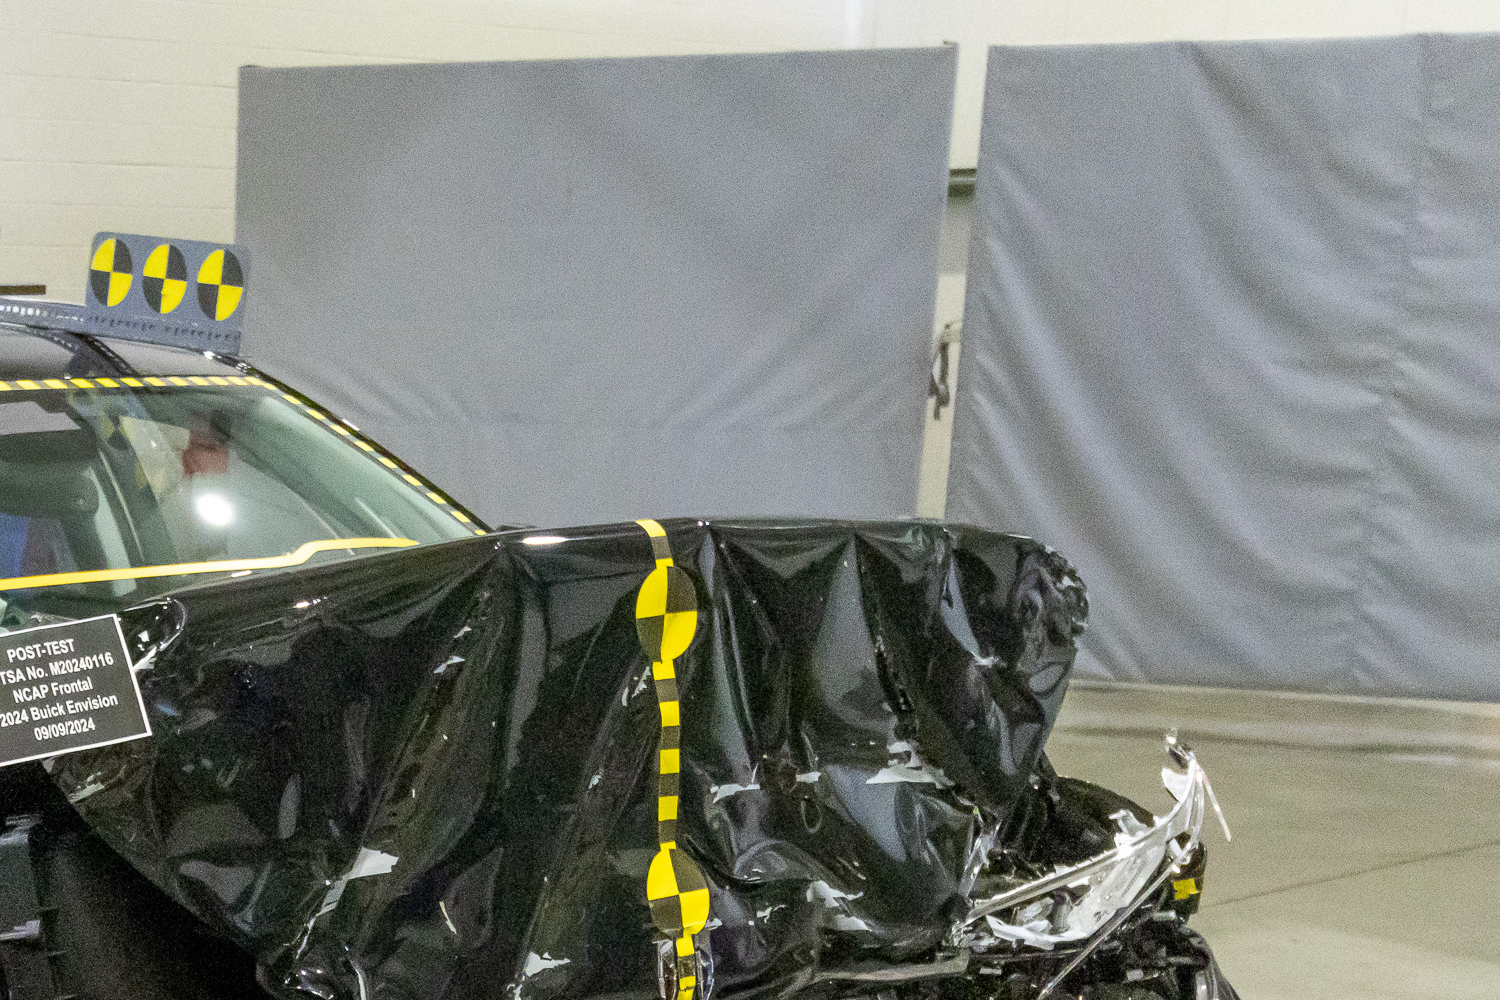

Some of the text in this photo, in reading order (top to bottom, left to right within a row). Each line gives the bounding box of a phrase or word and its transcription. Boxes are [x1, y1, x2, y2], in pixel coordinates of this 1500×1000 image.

[7, 638, 75, 663] POST-TEST
[28, 665, 48, 681] No.
[49, 652, 114, 677] M20240116
[13, 677, 93, 704] NCAP Frontal
[0, 693, 118, 727] 2024 Buick Envision
[34, 717, 96, 741] 09/09/2024
